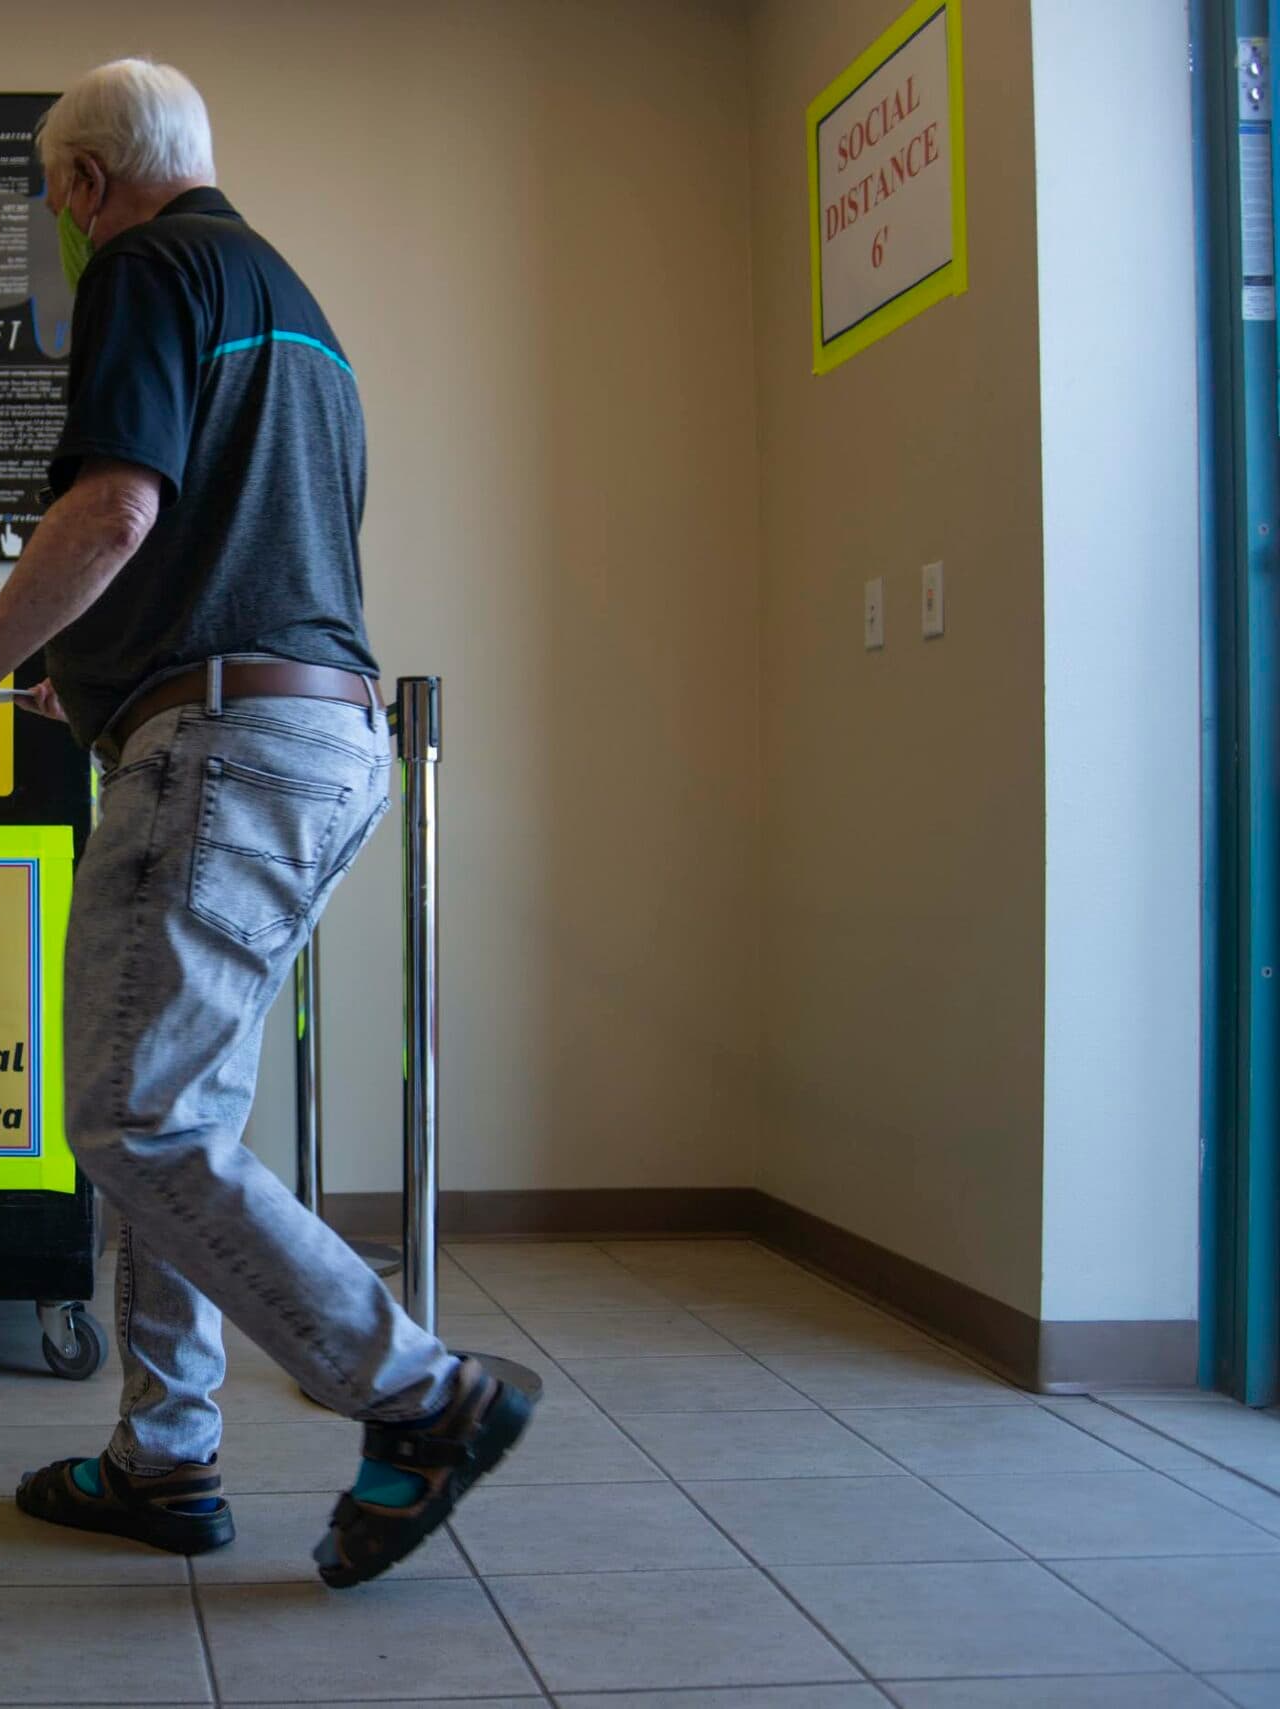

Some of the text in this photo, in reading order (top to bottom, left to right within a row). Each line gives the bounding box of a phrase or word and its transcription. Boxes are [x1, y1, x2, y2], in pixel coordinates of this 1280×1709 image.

[837, 73, 920, 172] SOCIAL
[826, 122, 940, 242] DISTANCE
[870, 225, 889, 268] 6'
